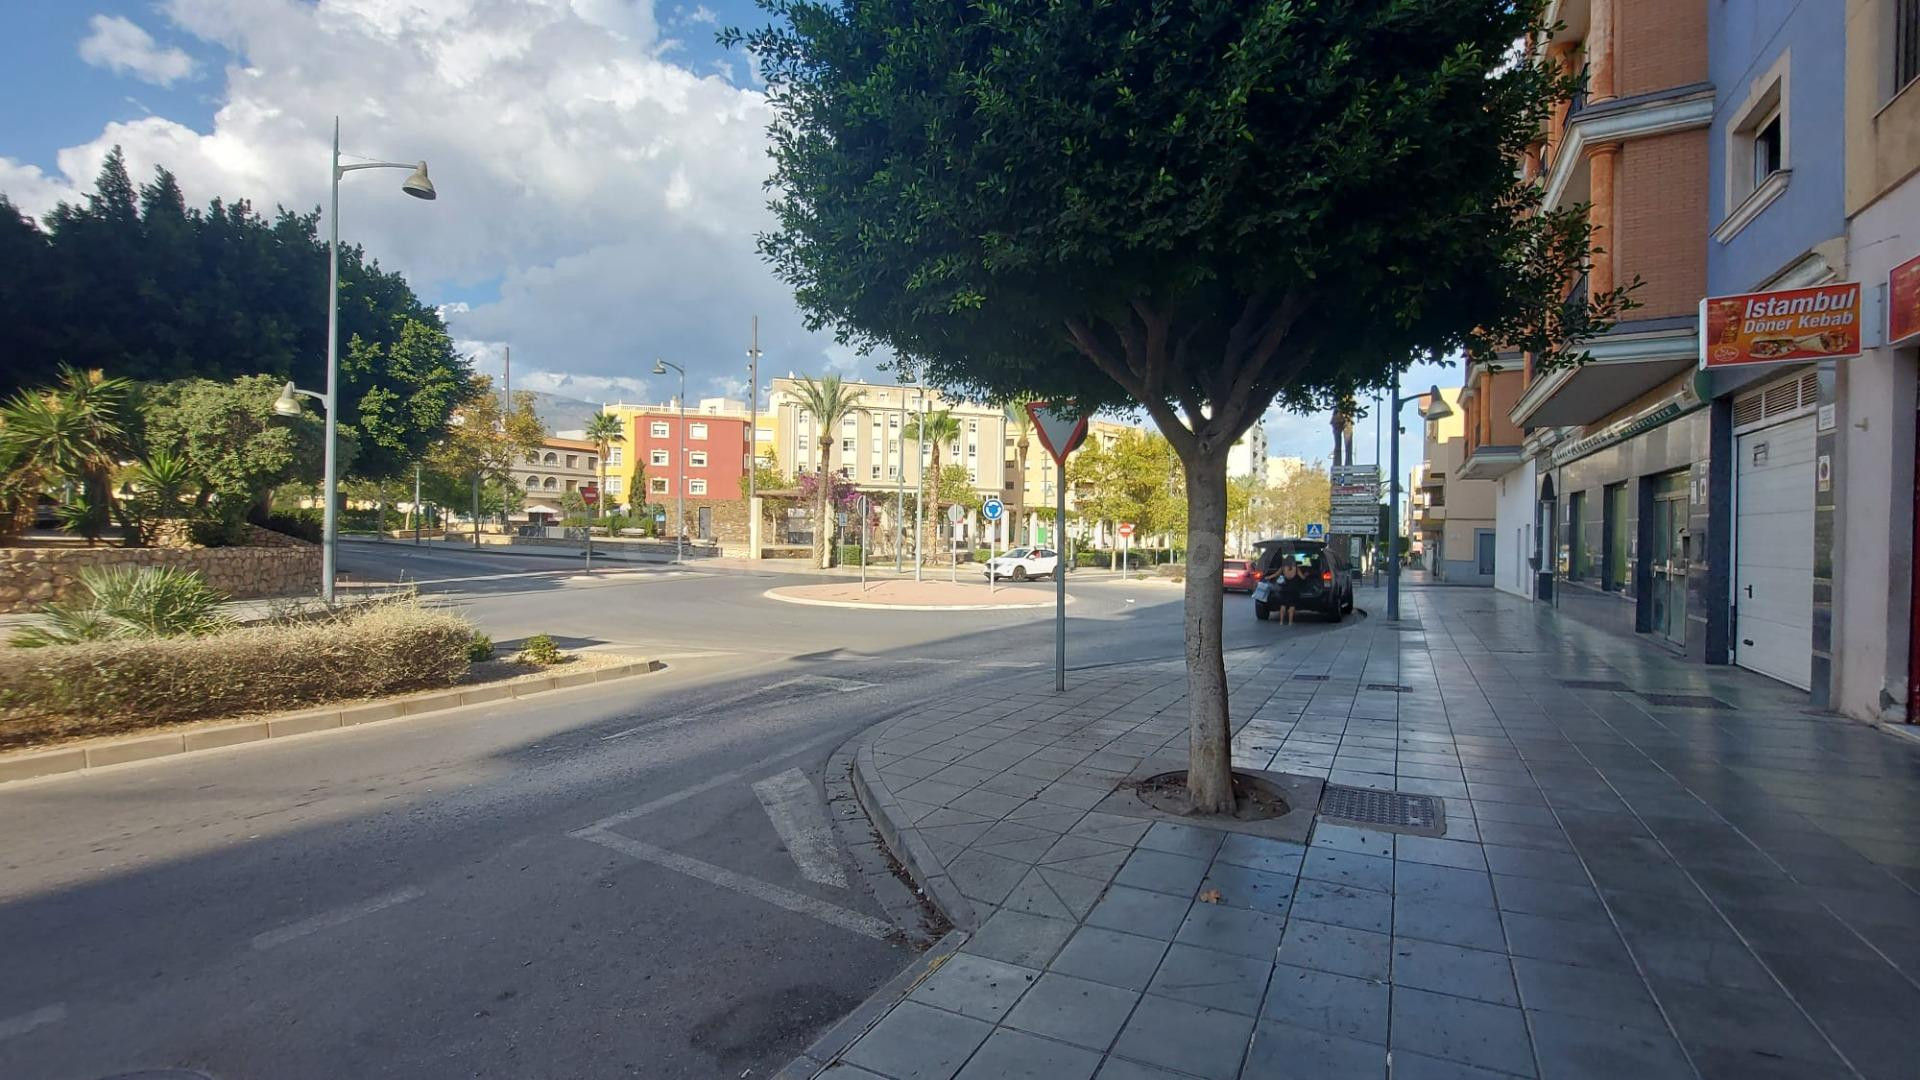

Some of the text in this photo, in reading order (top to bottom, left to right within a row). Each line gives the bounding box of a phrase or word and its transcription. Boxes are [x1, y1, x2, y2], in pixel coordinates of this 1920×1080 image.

[1745, 288, 1856, 319] Istambul
[1744, 312, 1853, 334] Döner Kebab
